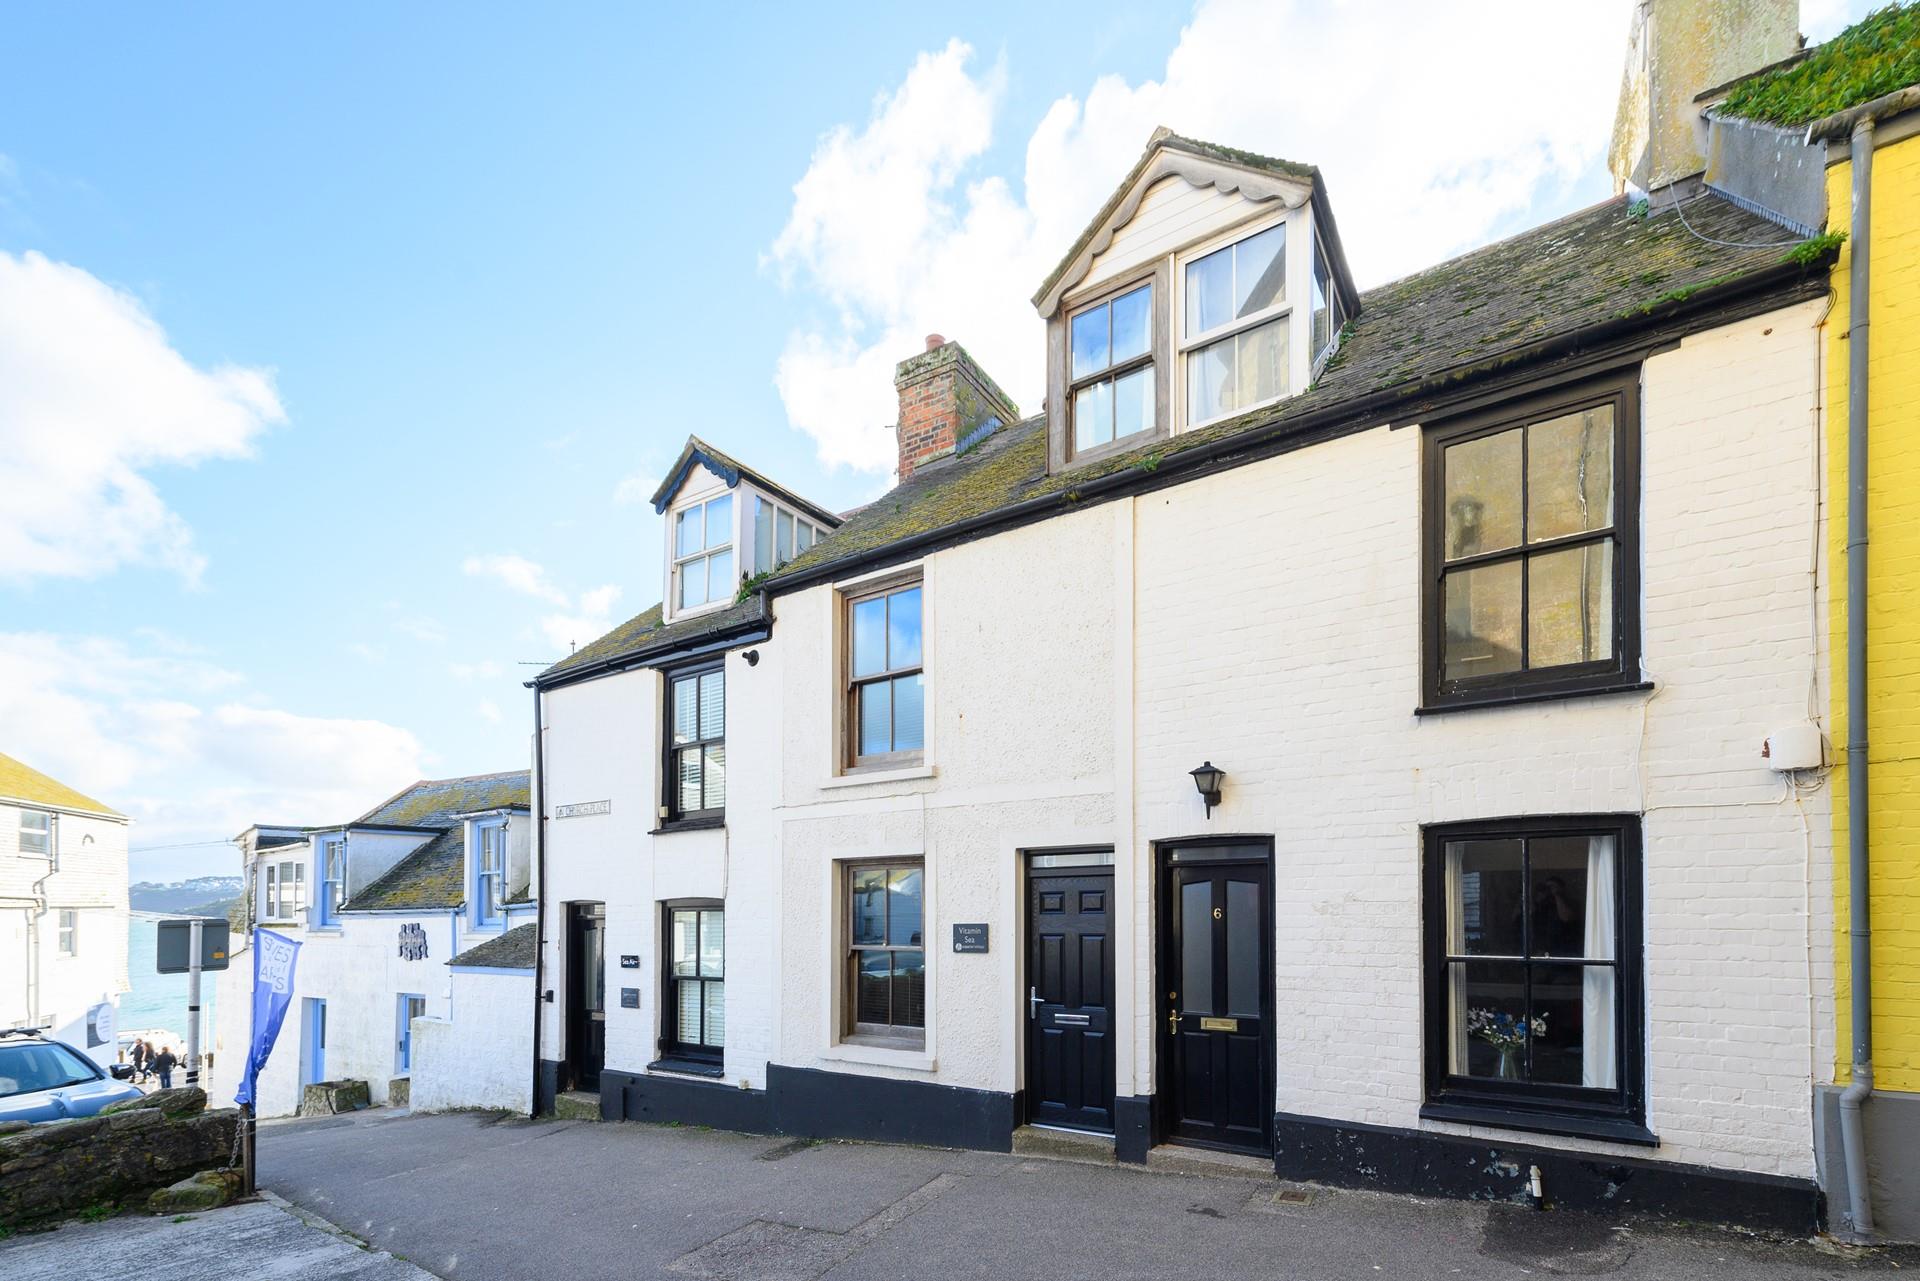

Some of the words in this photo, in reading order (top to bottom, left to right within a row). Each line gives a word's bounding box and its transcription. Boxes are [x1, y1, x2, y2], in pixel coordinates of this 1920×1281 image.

[1213, 907, 1222, 919] 6
[958, 927, 982, 935] Vitamin
[964, 935, 975, 943] Sea
